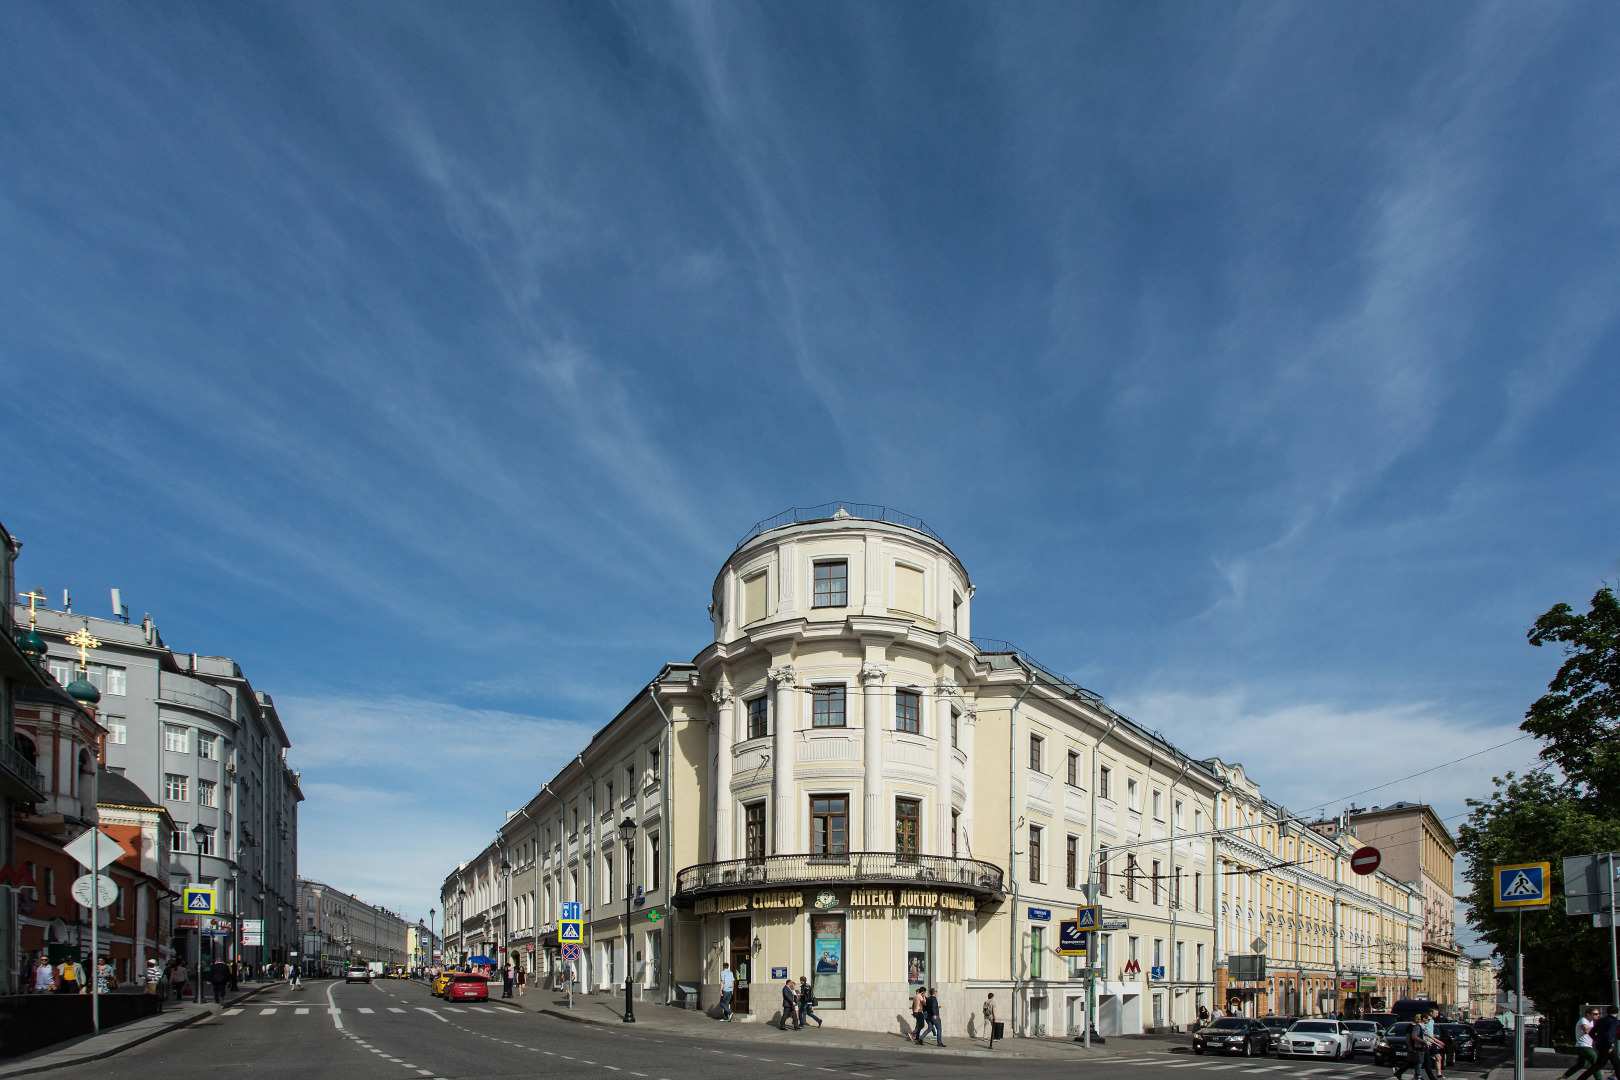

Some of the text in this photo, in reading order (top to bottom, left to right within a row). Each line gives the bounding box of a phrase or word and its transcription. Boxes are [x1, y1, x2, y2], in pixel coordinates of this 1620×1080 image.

[717, 895, 749, 913] ДОКТОР
[752, 891, 804, 909] СТОЛЕТОВ
[850, 889, 895, 906] АПТЕКА
[899, 889, 938, 908] ДОКТОР
[940, 892, 975, 911] СТОЛЕТОВ
